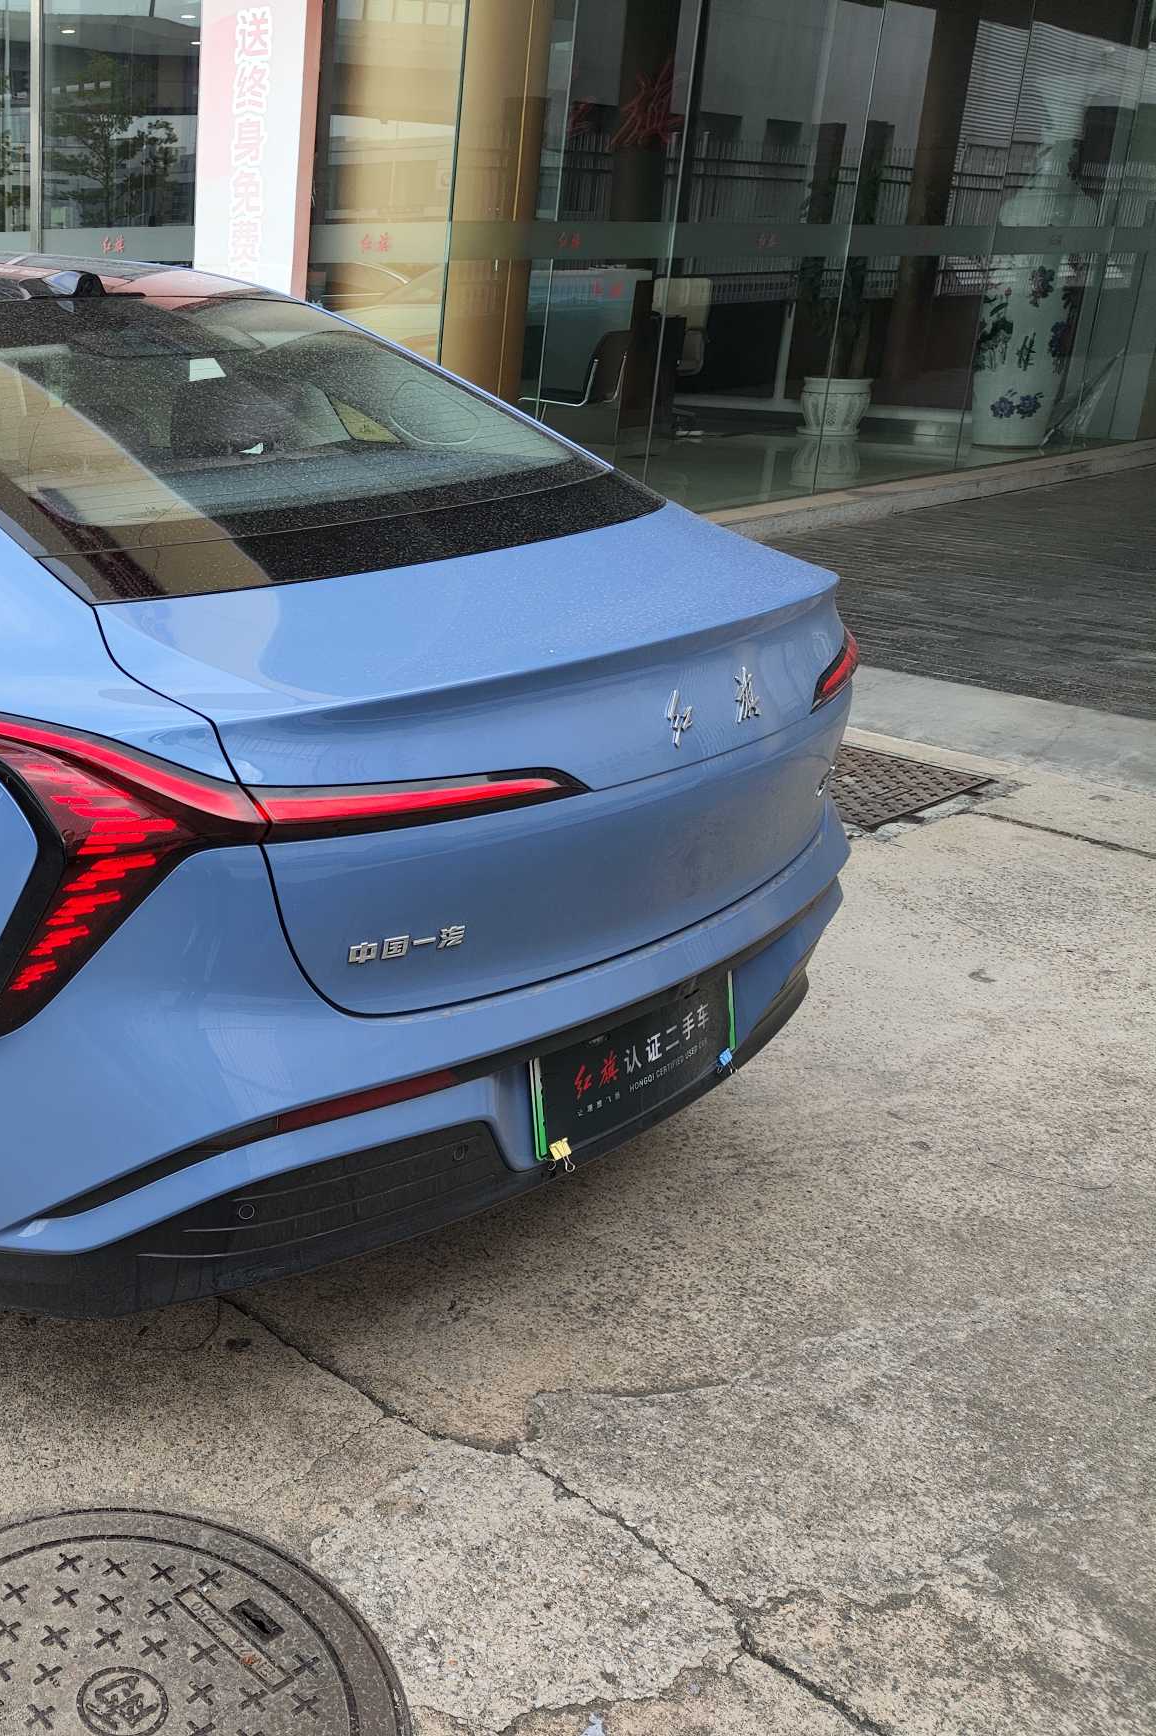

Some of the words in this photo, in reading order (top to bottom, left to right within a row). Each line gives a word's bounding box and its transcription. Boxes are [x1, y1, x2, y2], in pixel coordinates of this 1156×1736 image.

[348, 925, 466, 964] 中国一汽
[629, 1073, 656, 1093] HONGQI
